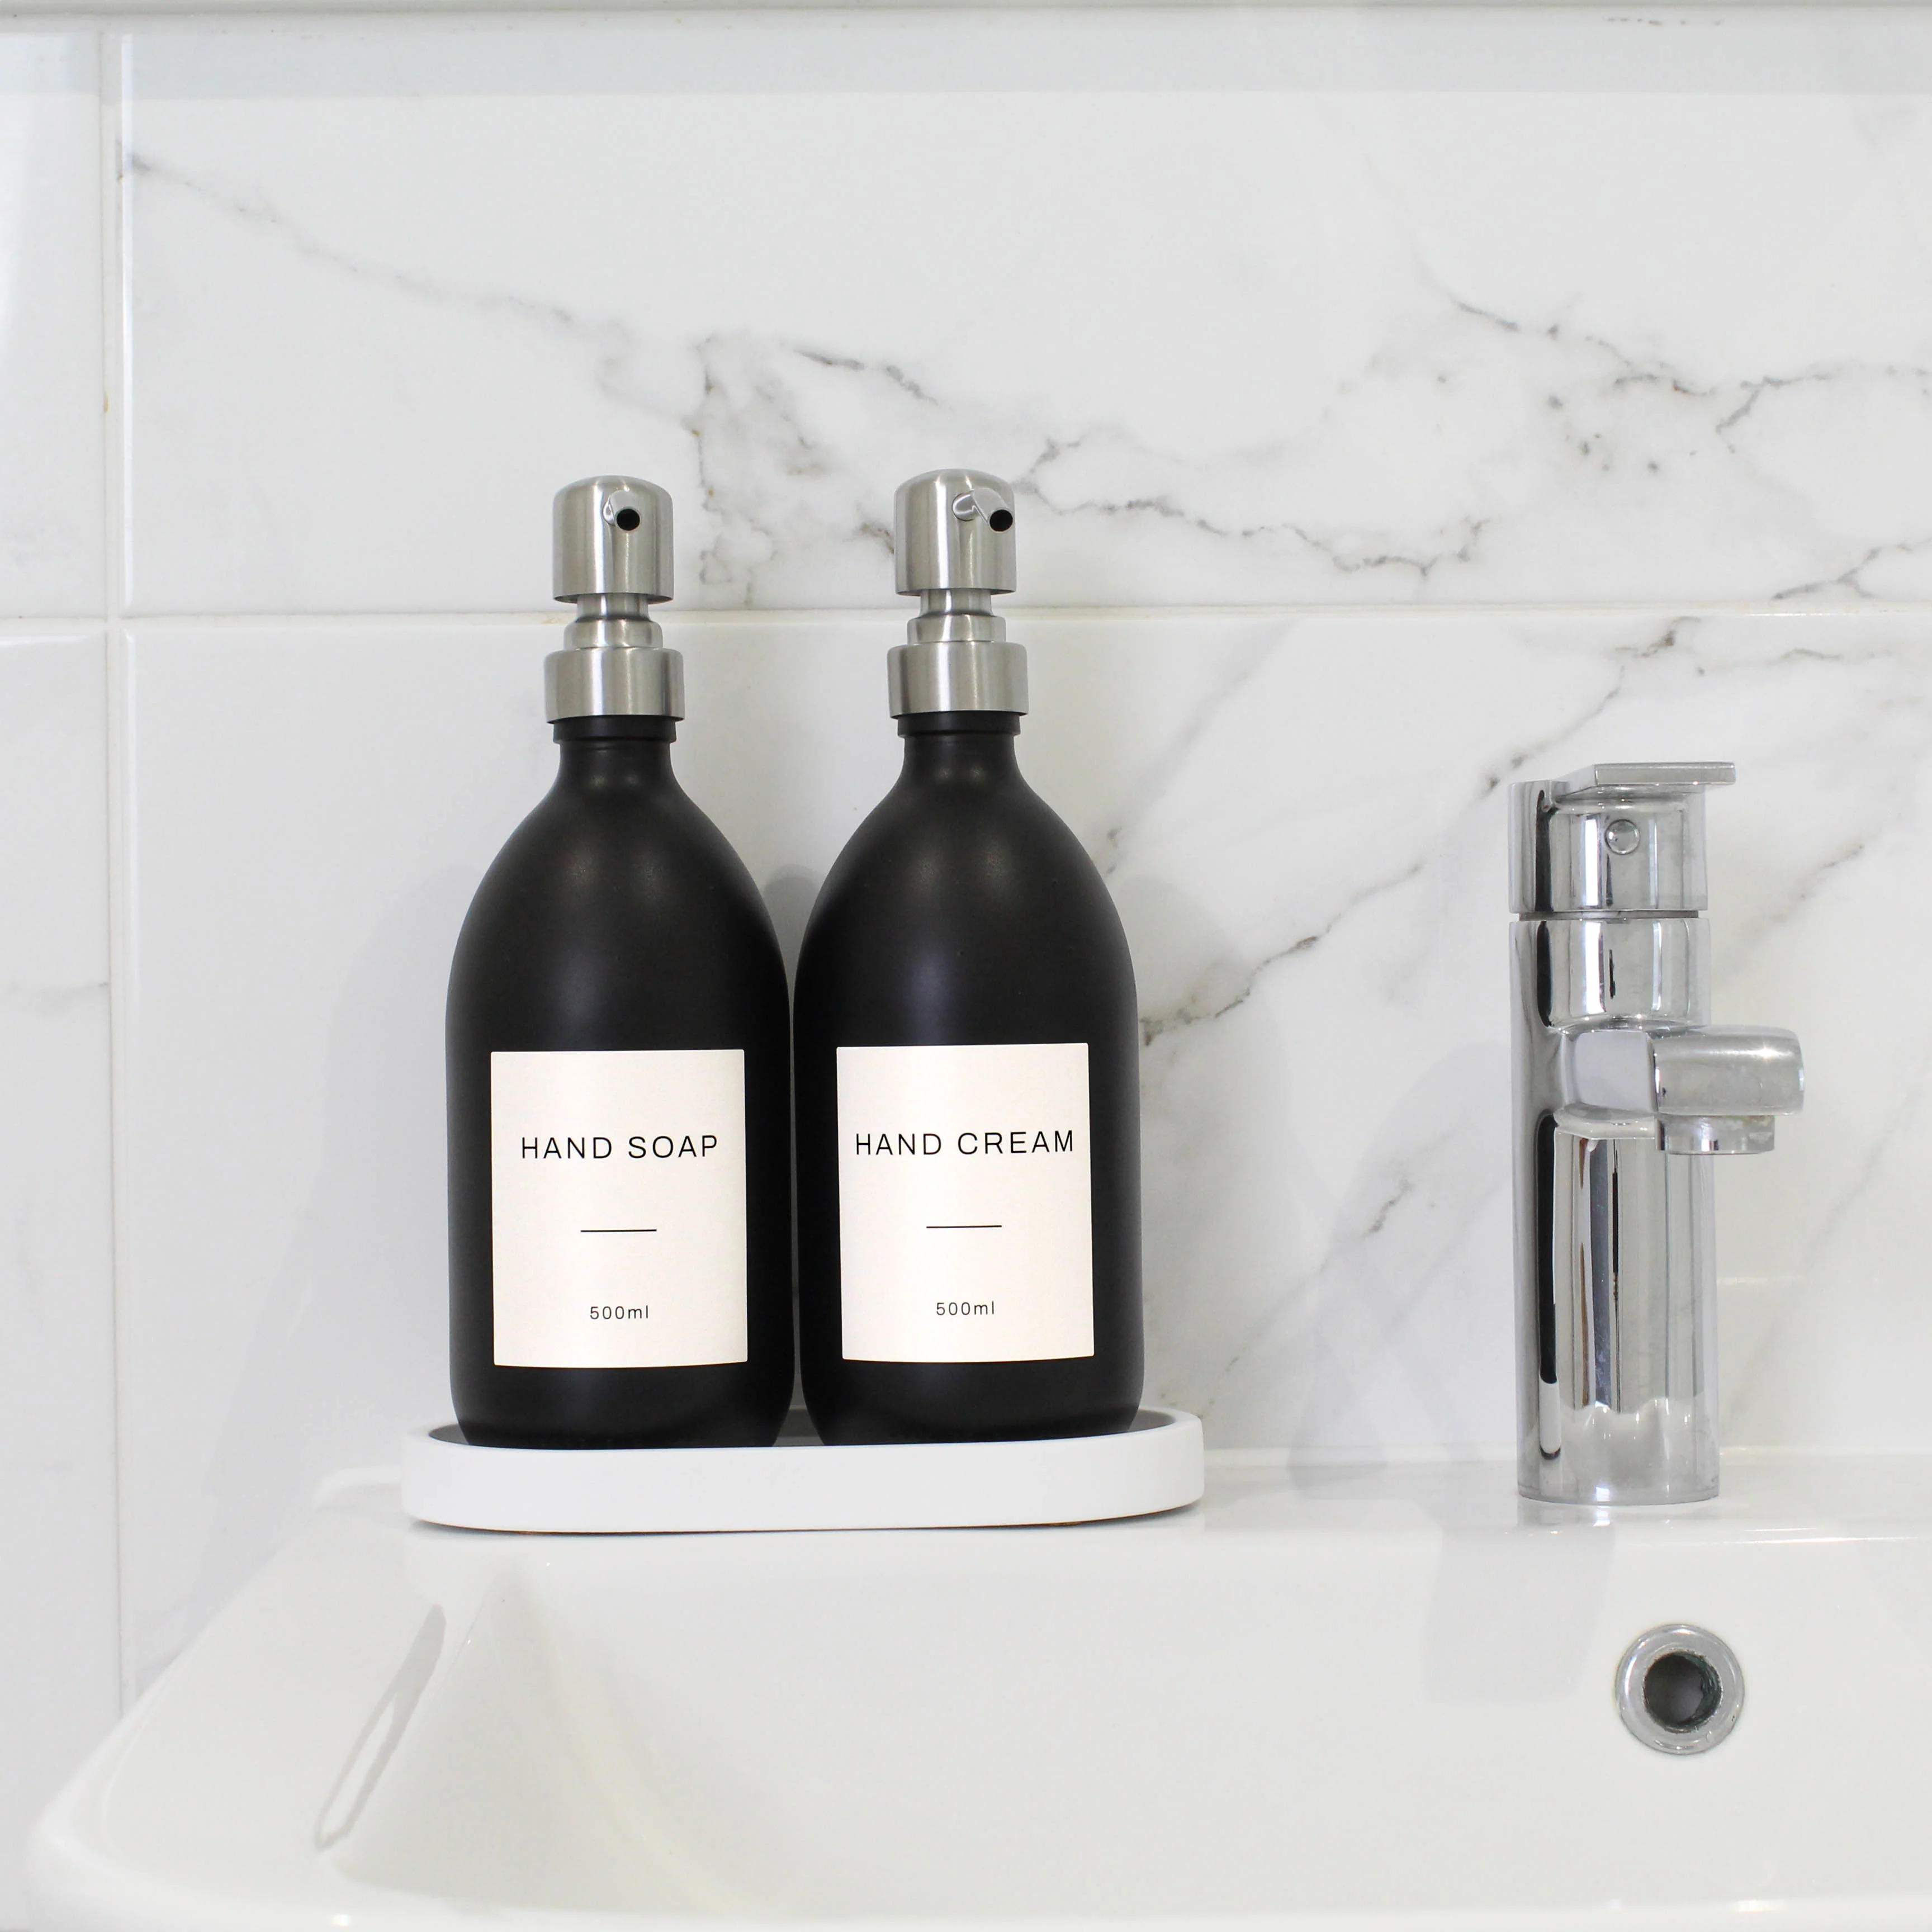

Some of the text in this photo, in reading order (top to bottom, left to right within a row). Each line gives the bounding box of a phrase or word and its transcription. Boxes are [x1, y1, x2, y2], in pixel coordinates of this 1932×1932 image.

[521, 1134, 718, 1159] HAND SOAP
[855, 1129, 1073, 1156] HAND CREAM
[589, 1304, 649, 1320] 500ml
[936, 1300, 995, 1316] 500ml
